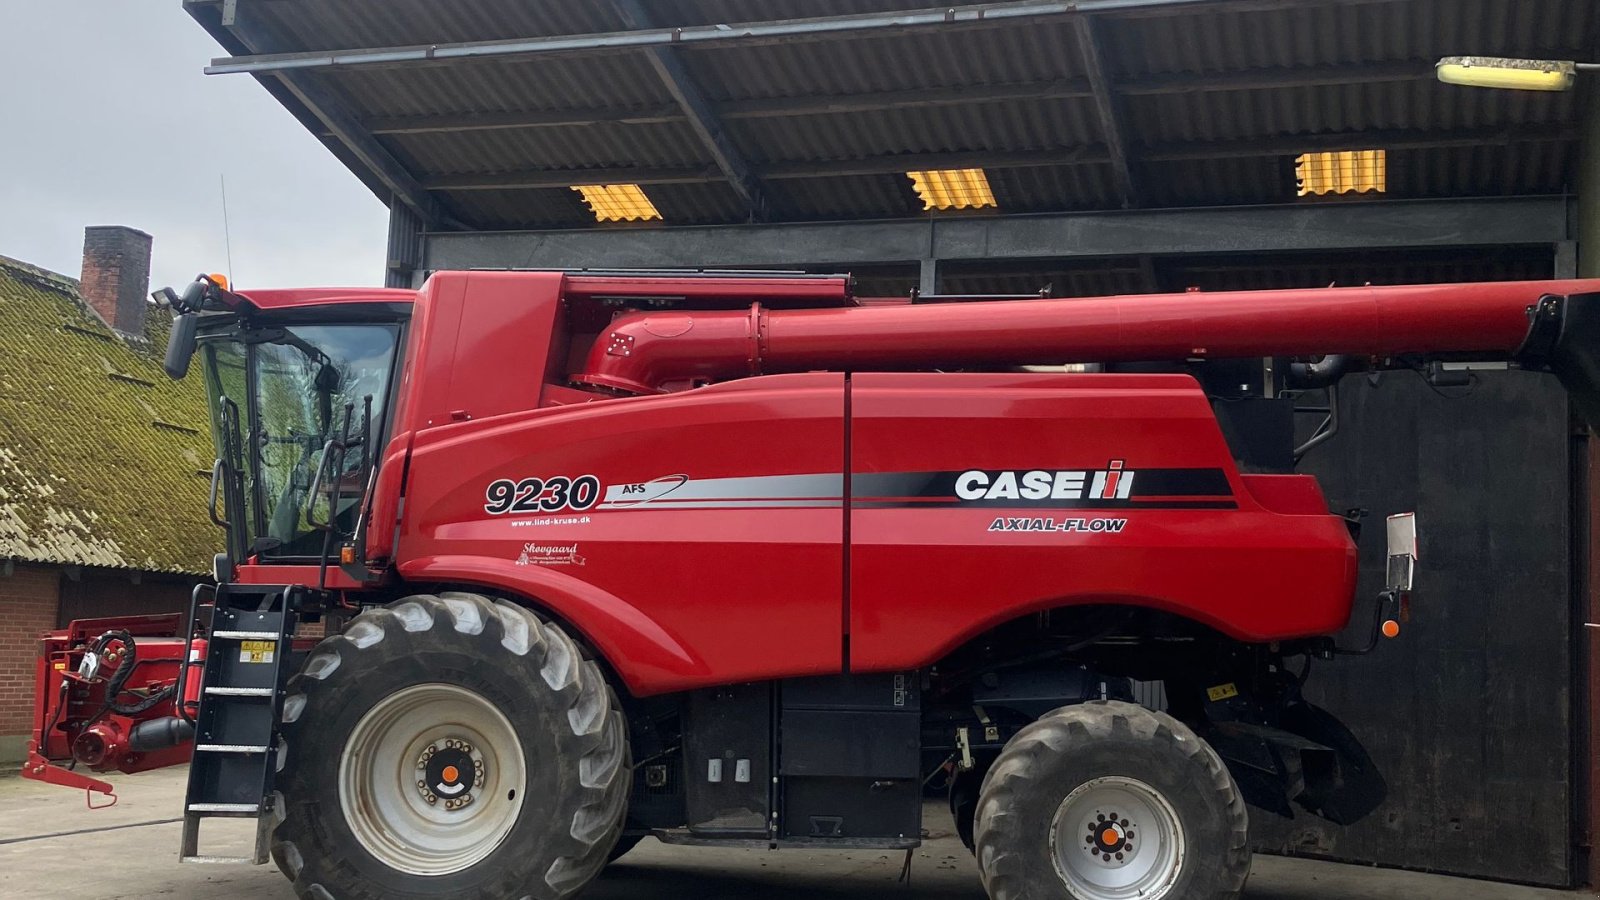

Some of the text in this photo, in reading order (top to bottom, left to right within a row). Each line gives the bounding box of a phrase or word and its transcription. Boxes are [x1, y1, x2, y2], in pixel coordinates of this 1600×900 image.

[622, 483, 646, 495] AFS
[954, 470, 1087, 500] CASE
[484, 474, 600, 515] 9230
[511, 516, 591, 527] www.lind-kruse.dk
[987, 517, 1128, 533] AXIAL-FLOW
[522, 542, 578, 556] Skovgaard
